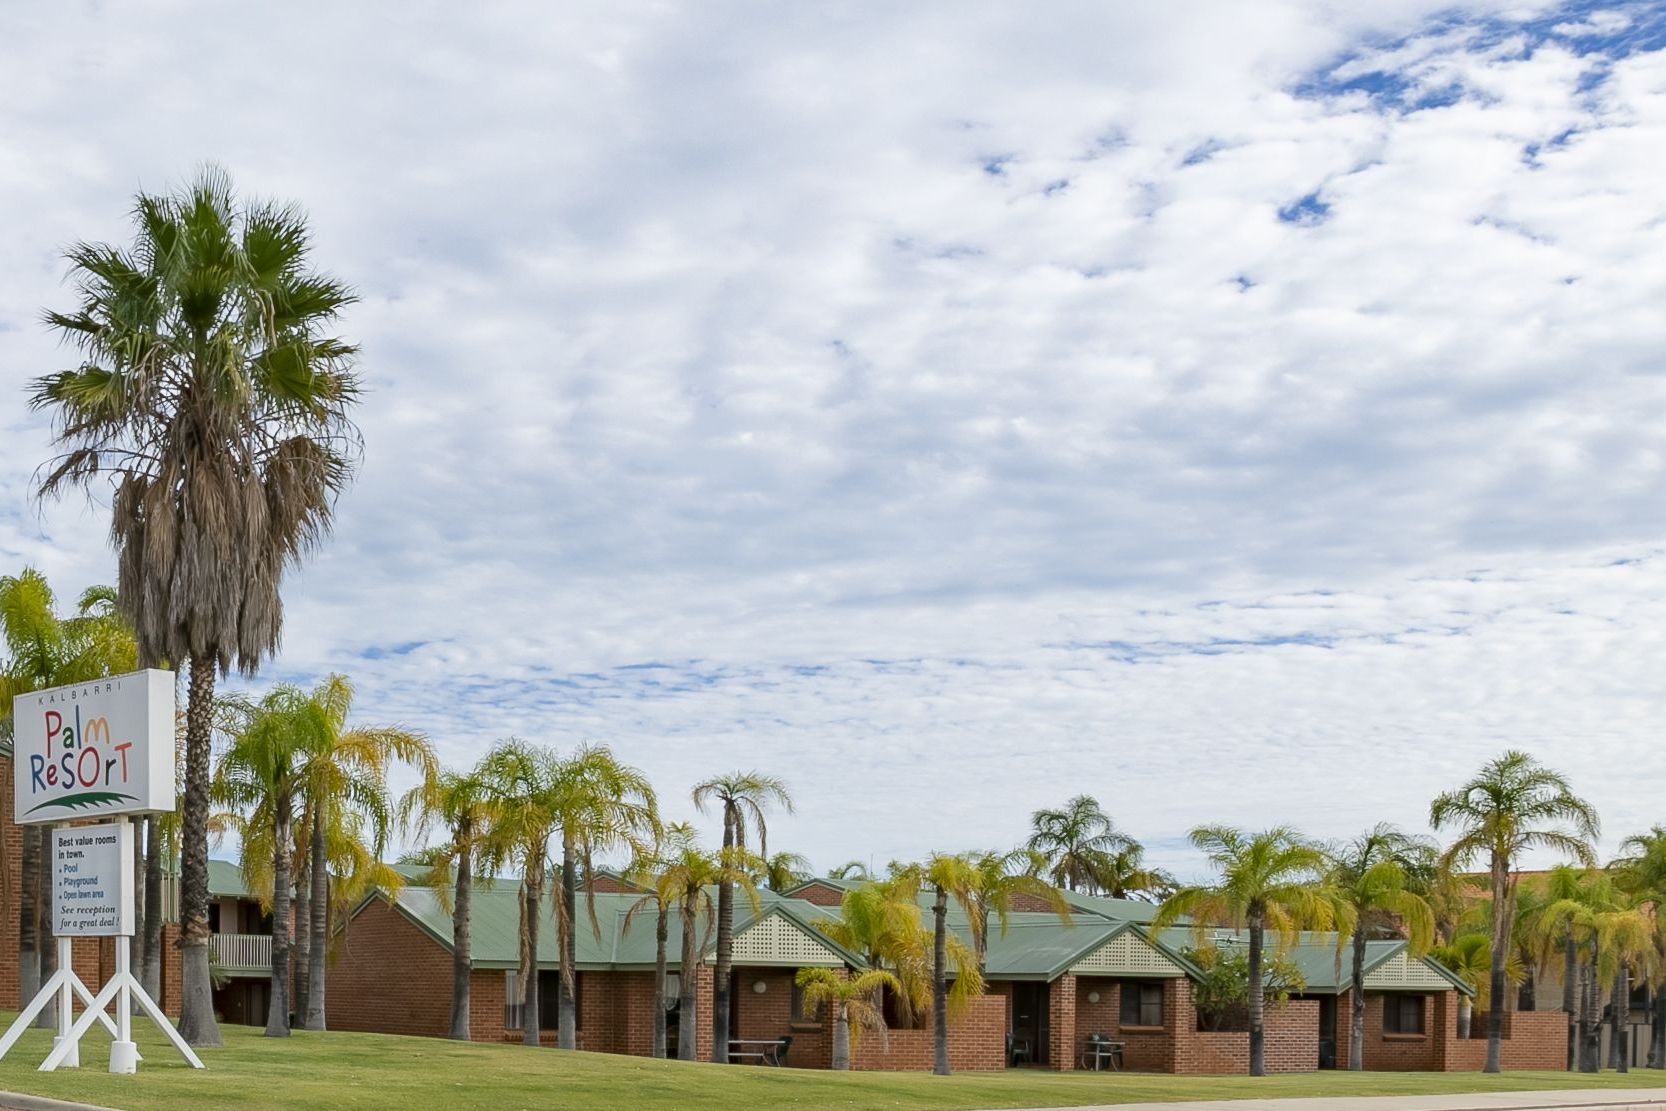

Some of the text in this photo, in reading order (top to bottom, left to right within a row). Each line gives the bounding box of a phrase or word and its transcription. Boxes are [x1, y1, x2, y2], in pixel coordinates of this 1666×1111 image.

[38, 682, 121, 705] KALBARRI
[45, 704, 110, 759] Palm
[58, 835, 116, 847] Best value rooms
[58, 850, 85, 859] in town.
[63, 863, 78, 873] Pool
[63, 876, 98, 888] Playground
[63, 890, 104, 900] Open lawn area
[61, 904, 115, 916] See reception
[60, 918, 71, 930] for
[79, 919, 98, 930] great
